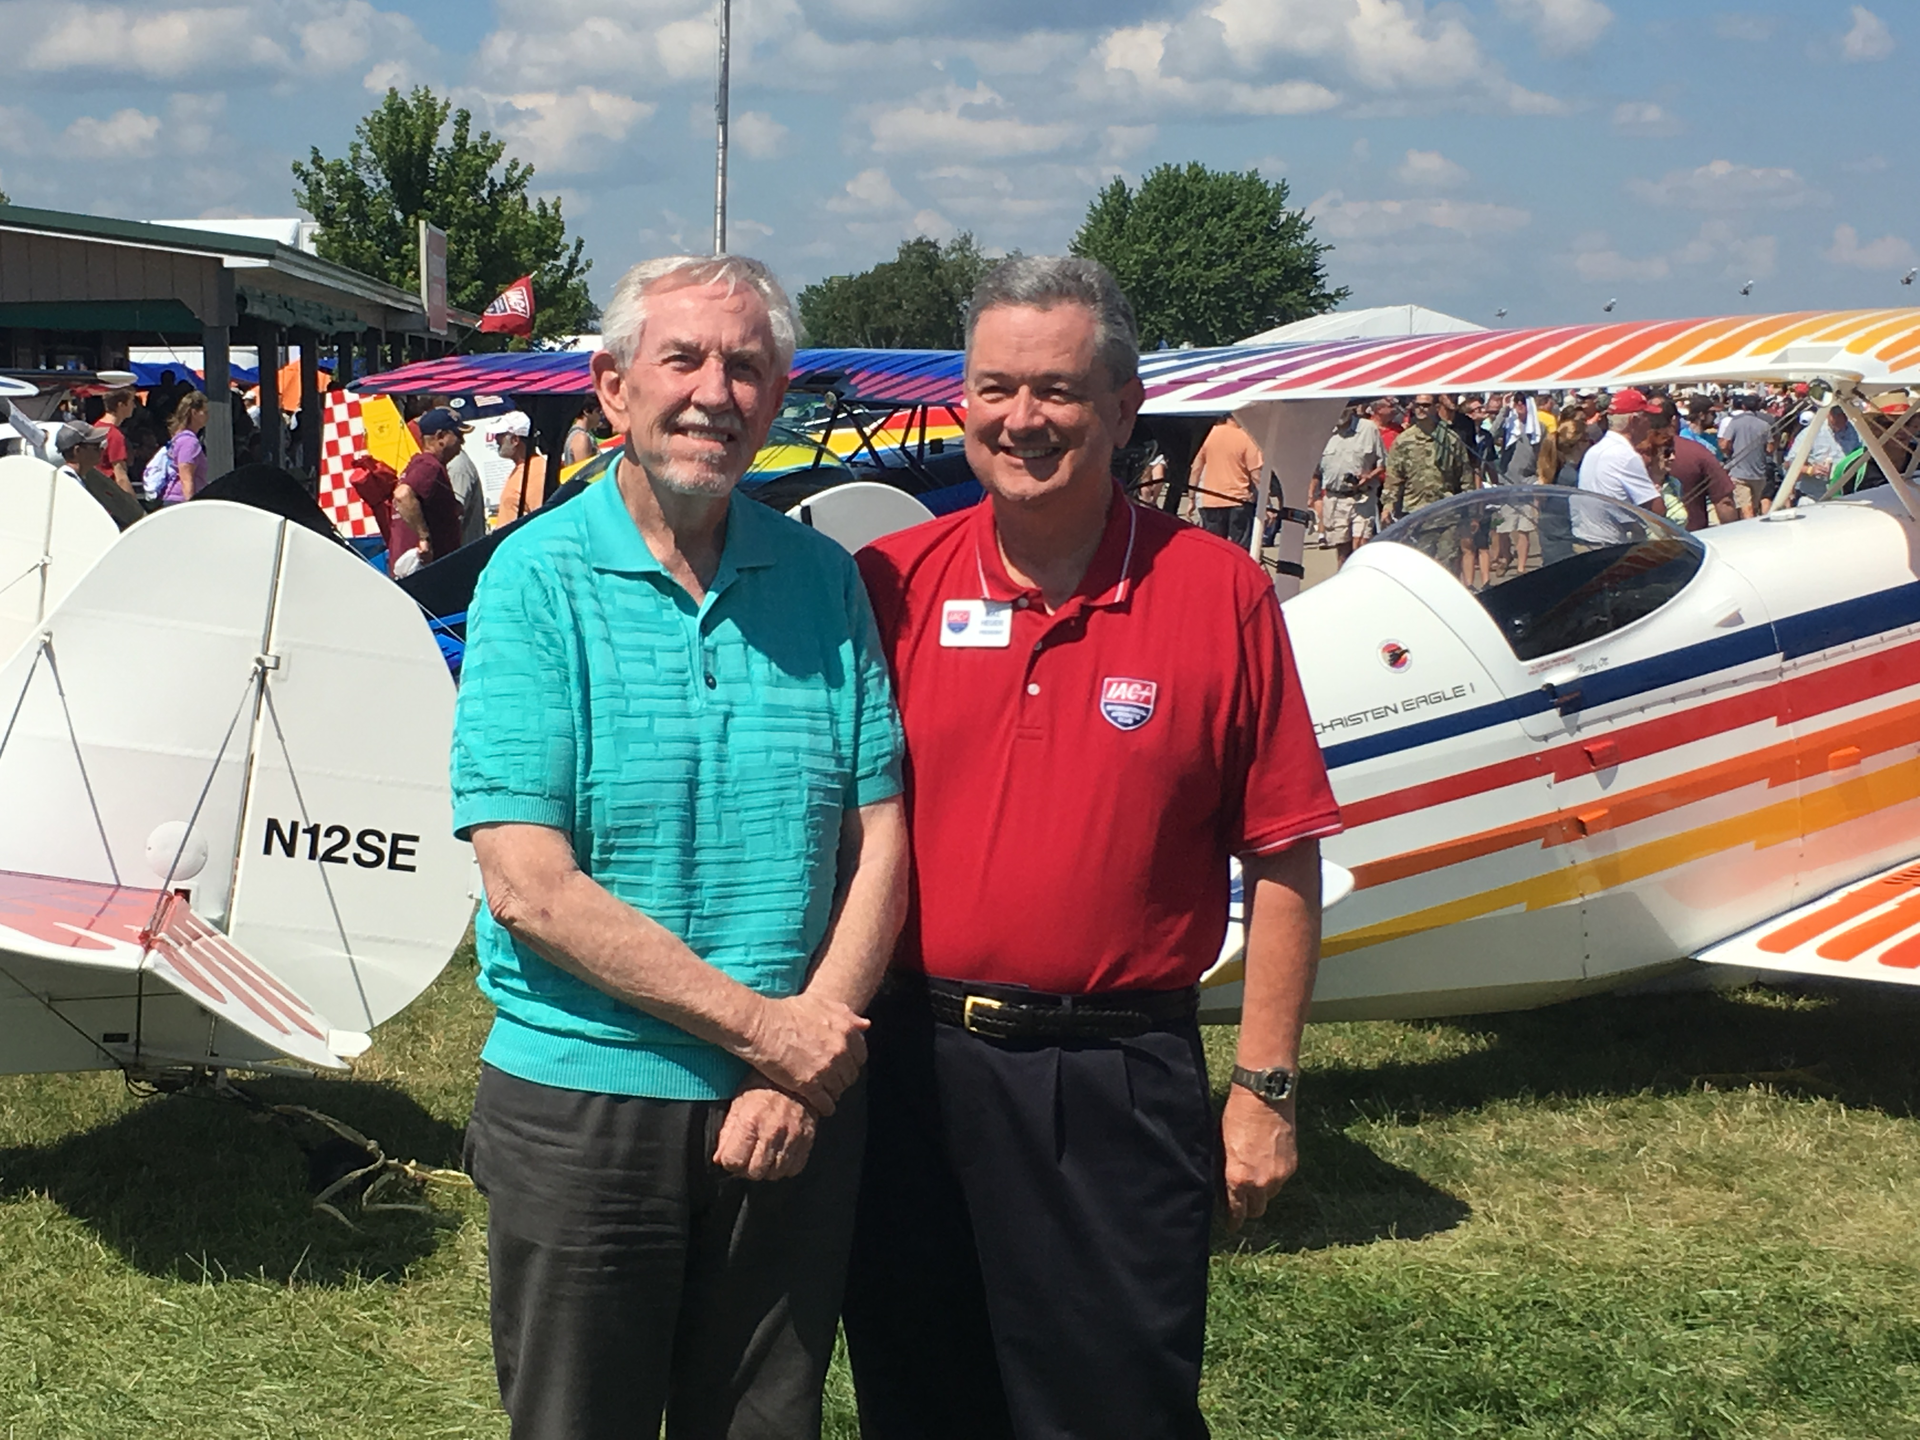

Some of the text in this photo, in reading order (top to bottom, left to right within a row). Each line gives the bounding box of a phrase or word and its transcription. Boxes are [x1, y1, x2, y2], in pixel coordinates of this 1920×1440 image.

[1313, 703, 1399, 735] CHRISTEN
[1401, 684, 1466, 712] EAGLE
[262, 817, 420, 873] N12SE
